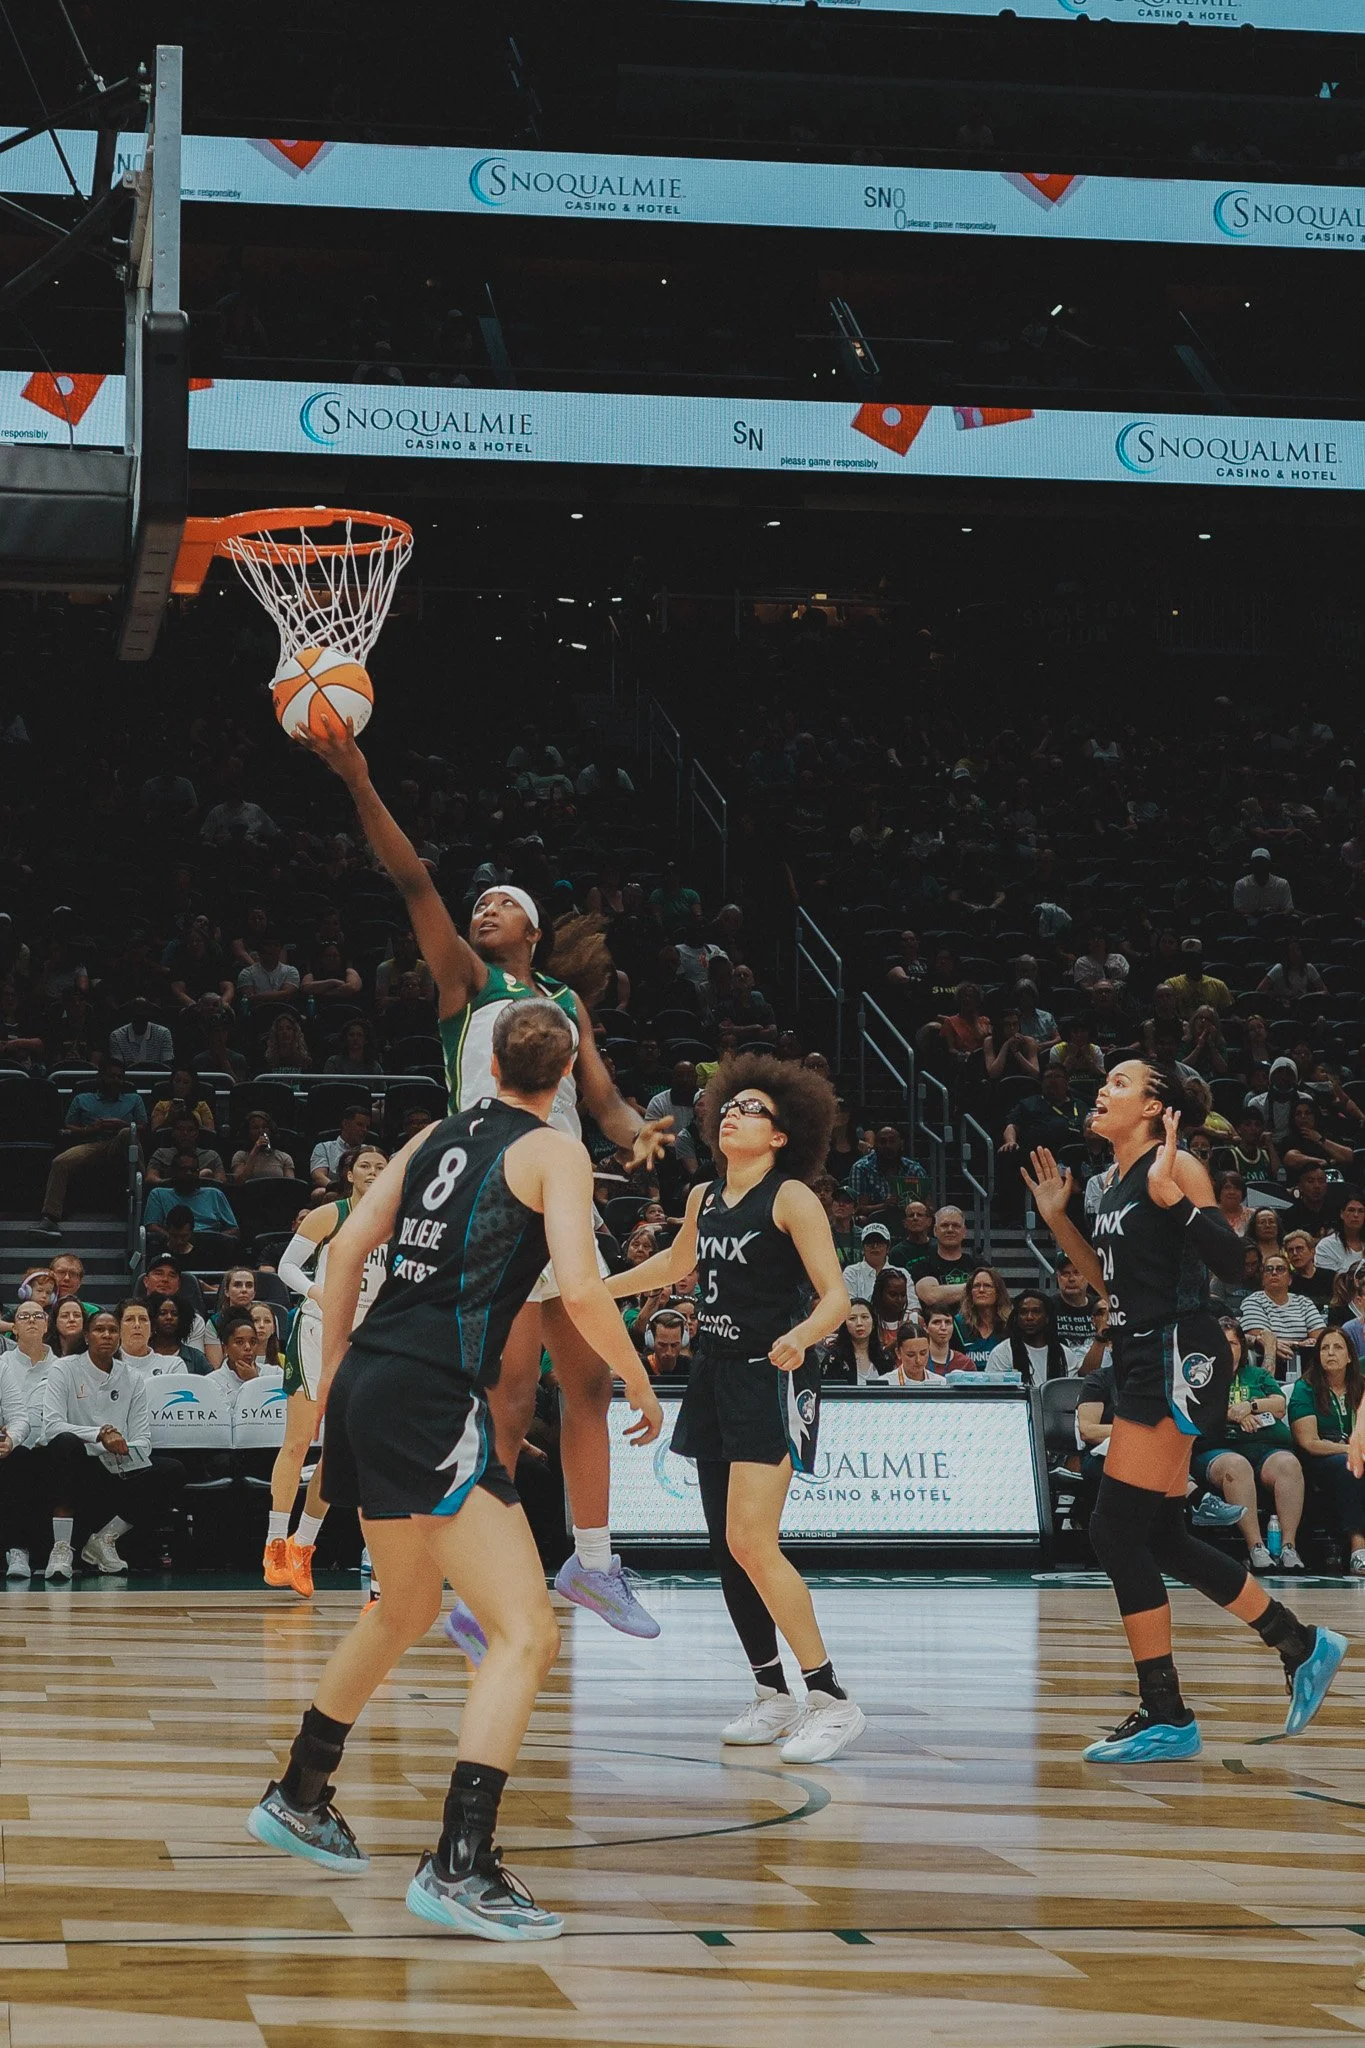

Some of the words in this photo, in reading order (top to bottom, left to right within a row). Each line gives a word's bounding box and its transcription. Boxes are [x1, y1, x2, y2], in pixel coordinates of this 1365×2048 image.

[1138, 9, 1182, 18] CASINO
[1187, 11, 1194, 19] &
[1200, 12, 1237, 21] HOTEL
[489, 165, 682, 198] SNOQUALMIE
[565, 201, 616, 212] CASINO
[623, 203, 630, 212] &
[637, 203, 681, 214] HOTEL
[1233, 197, 1365, 230] SNOQUAL
[907, 219, 930, 228] please
[933, 221, 953, 229] game
[955, 221, 997, 232] responsibly
[1305, 232, 1355, 243] CASINO
[322, 400, 533, 437] SNOQUALMIE
[0, 429, 48, 440] responsibly
[405, 439, 462, 450] CASINO
[469, 441, 477, 451] &
[484, 441, 532, 453] HOTEL
[1137, 429, 1337, 465] SNOQUALMIE
[780, 456, 806, 466] please
[808, 457, 831, 468] game
[833, 457, 878, 469] responsibly
[1216, 467, 1270, 479] CASINO
[1276, 470, 1284, 479] &
[1291, 470, 1337, 481] HOTEL
[422, 1146, 468, 1211] 8
[1091, 1202, 1139, 1238] YNX
[697, 1231, 762, 1265] YNX
[1097, 1245, 1115, 1280] 24
[705, 1269, 719, 1304] 5
[151, 1409, 218, 1420] YMETRA
[241, 1408, 285, 1419] SYME
[790, 1489, 861, 1501] CASINO
[871, 1489, 881, 1501] &
[890, 1489, 951, 1501] HOTEL
